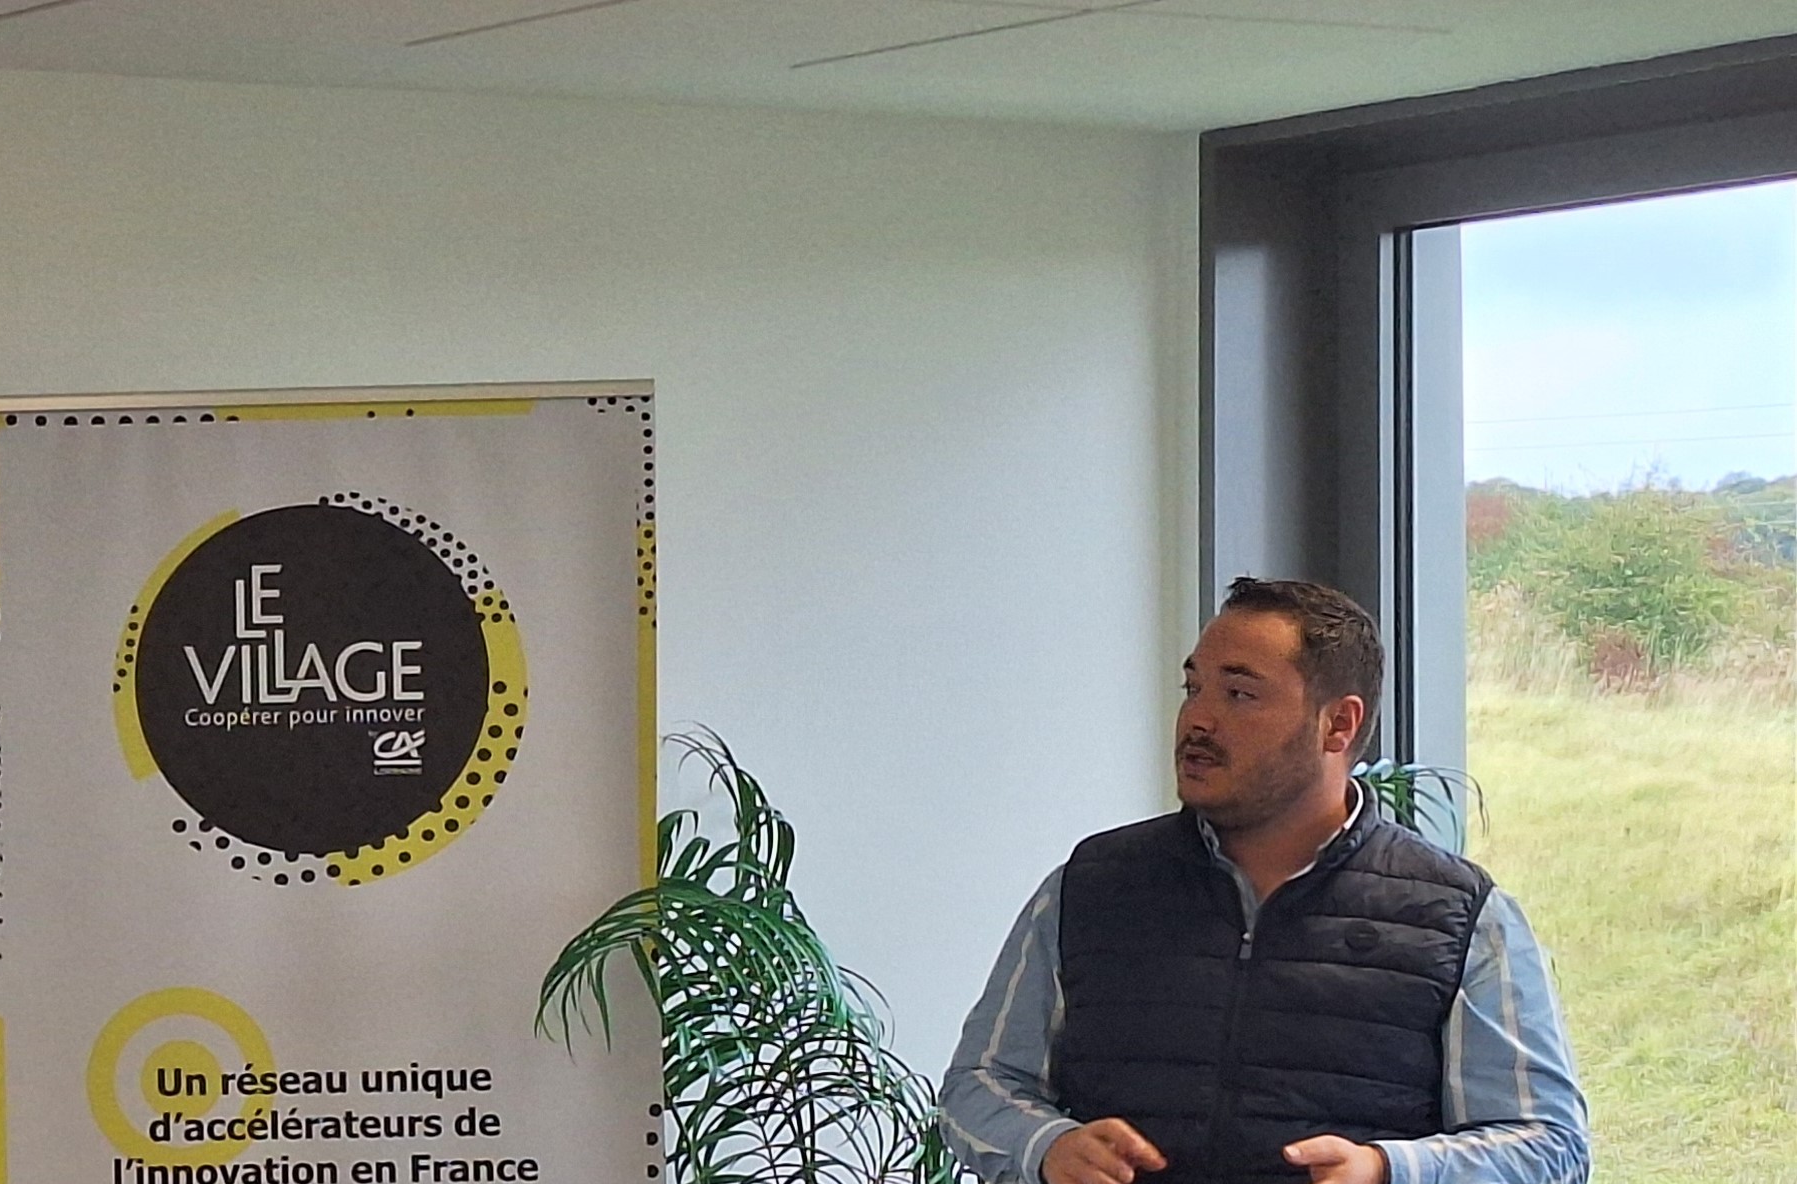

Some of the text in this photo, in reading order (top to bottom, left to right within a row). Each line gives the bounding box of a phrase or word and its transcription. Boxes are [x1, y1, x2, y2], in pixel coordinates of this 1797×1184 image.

[235, 564, 284, 639] LE
[183, 629, 425, 705] VILLAGE
[184, 705, 426, 732] Coopérer pour innover
[156, 1062, 493, 1099] Un réseau unique
[454, 1107, 502, 1137] de
[351, 1161, 397, 1184] en
[411, 1153, 540, 1183] France
